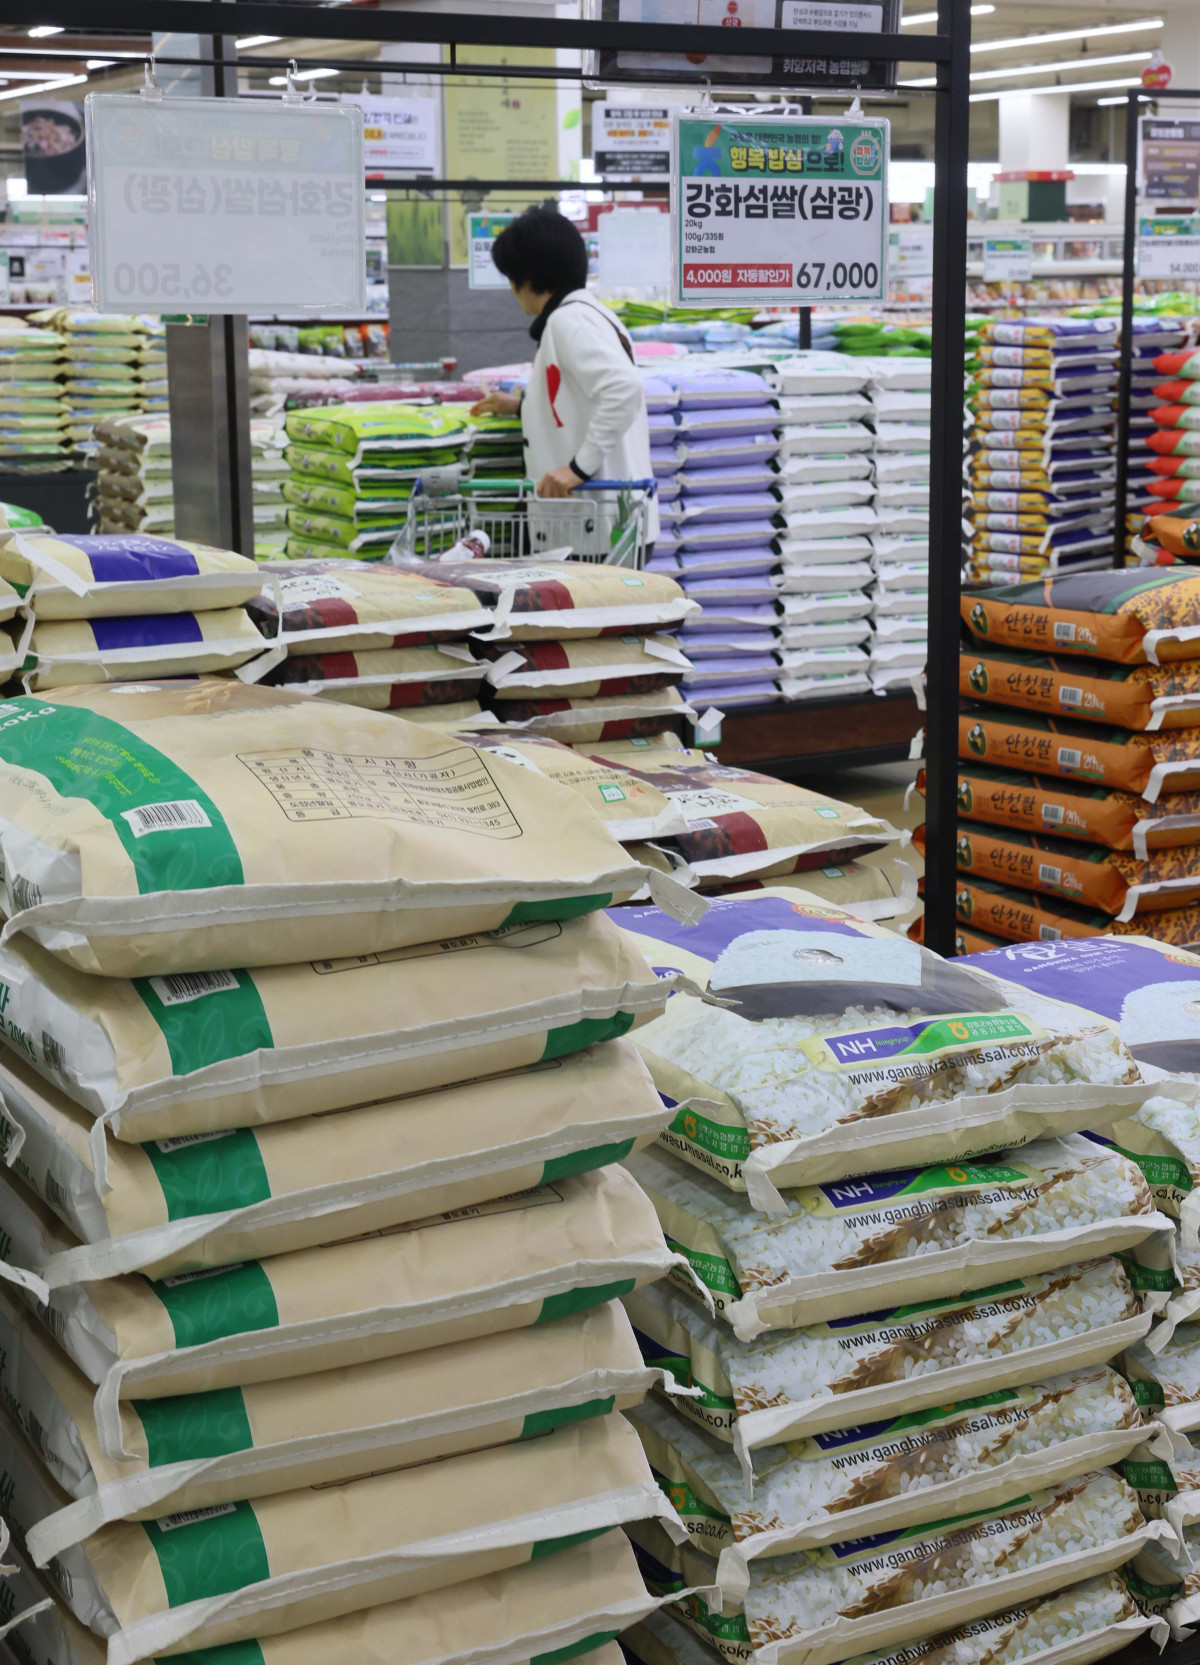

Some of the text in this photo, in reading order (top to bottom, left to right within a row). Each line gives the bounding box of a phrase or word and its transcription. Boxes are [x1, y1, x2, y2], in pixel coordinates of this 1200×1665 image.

[754, 133, 785, 144] 대한민국
[729, 145, 766, 171] 행복
[686, 183, 874, 221] 강화섬쌀(삼광)
[685, 220, 703, 229] 20kg
[685, 232, 724, 242] 100g/335원
[685, 245, 715, 254] 강화군농협
[686, 269, 790, 284] 4,000원 자동할인가
[796, 262, 878, 291] 67,000
[1006, 611, 1048, 636] 안성쌀
[1007, 671, 1054, 699] 안성쌀
[1005, 733, 1053, 760] 안성쌀
[990, 790, 1036, 816] 안성쌀
[990, 848, 1034, 876] 안성쌀
[990, 904, 1034, 936] 안성쌀
[837, 1036, 909, 1056] NH NongHyup
[848, 1043, 1041, 1085] www.ganghwasumssal.co.kr
[831, 1182, 874, 1201] NH
[844, 1185, 1040, 1230] www.ganghwasumssal.co.kr
[837, 1294, 1038, 1351] www.ganghwasumssal.co.kr
[831, 1406, 1030, 1471] www.ganghwasumssal.co.kr
[847, 1510, 1043, 1577] www.ganghwasumssal.co.kr
[872, 1606, 1030, 1665] anghwasumssal.co.kr
